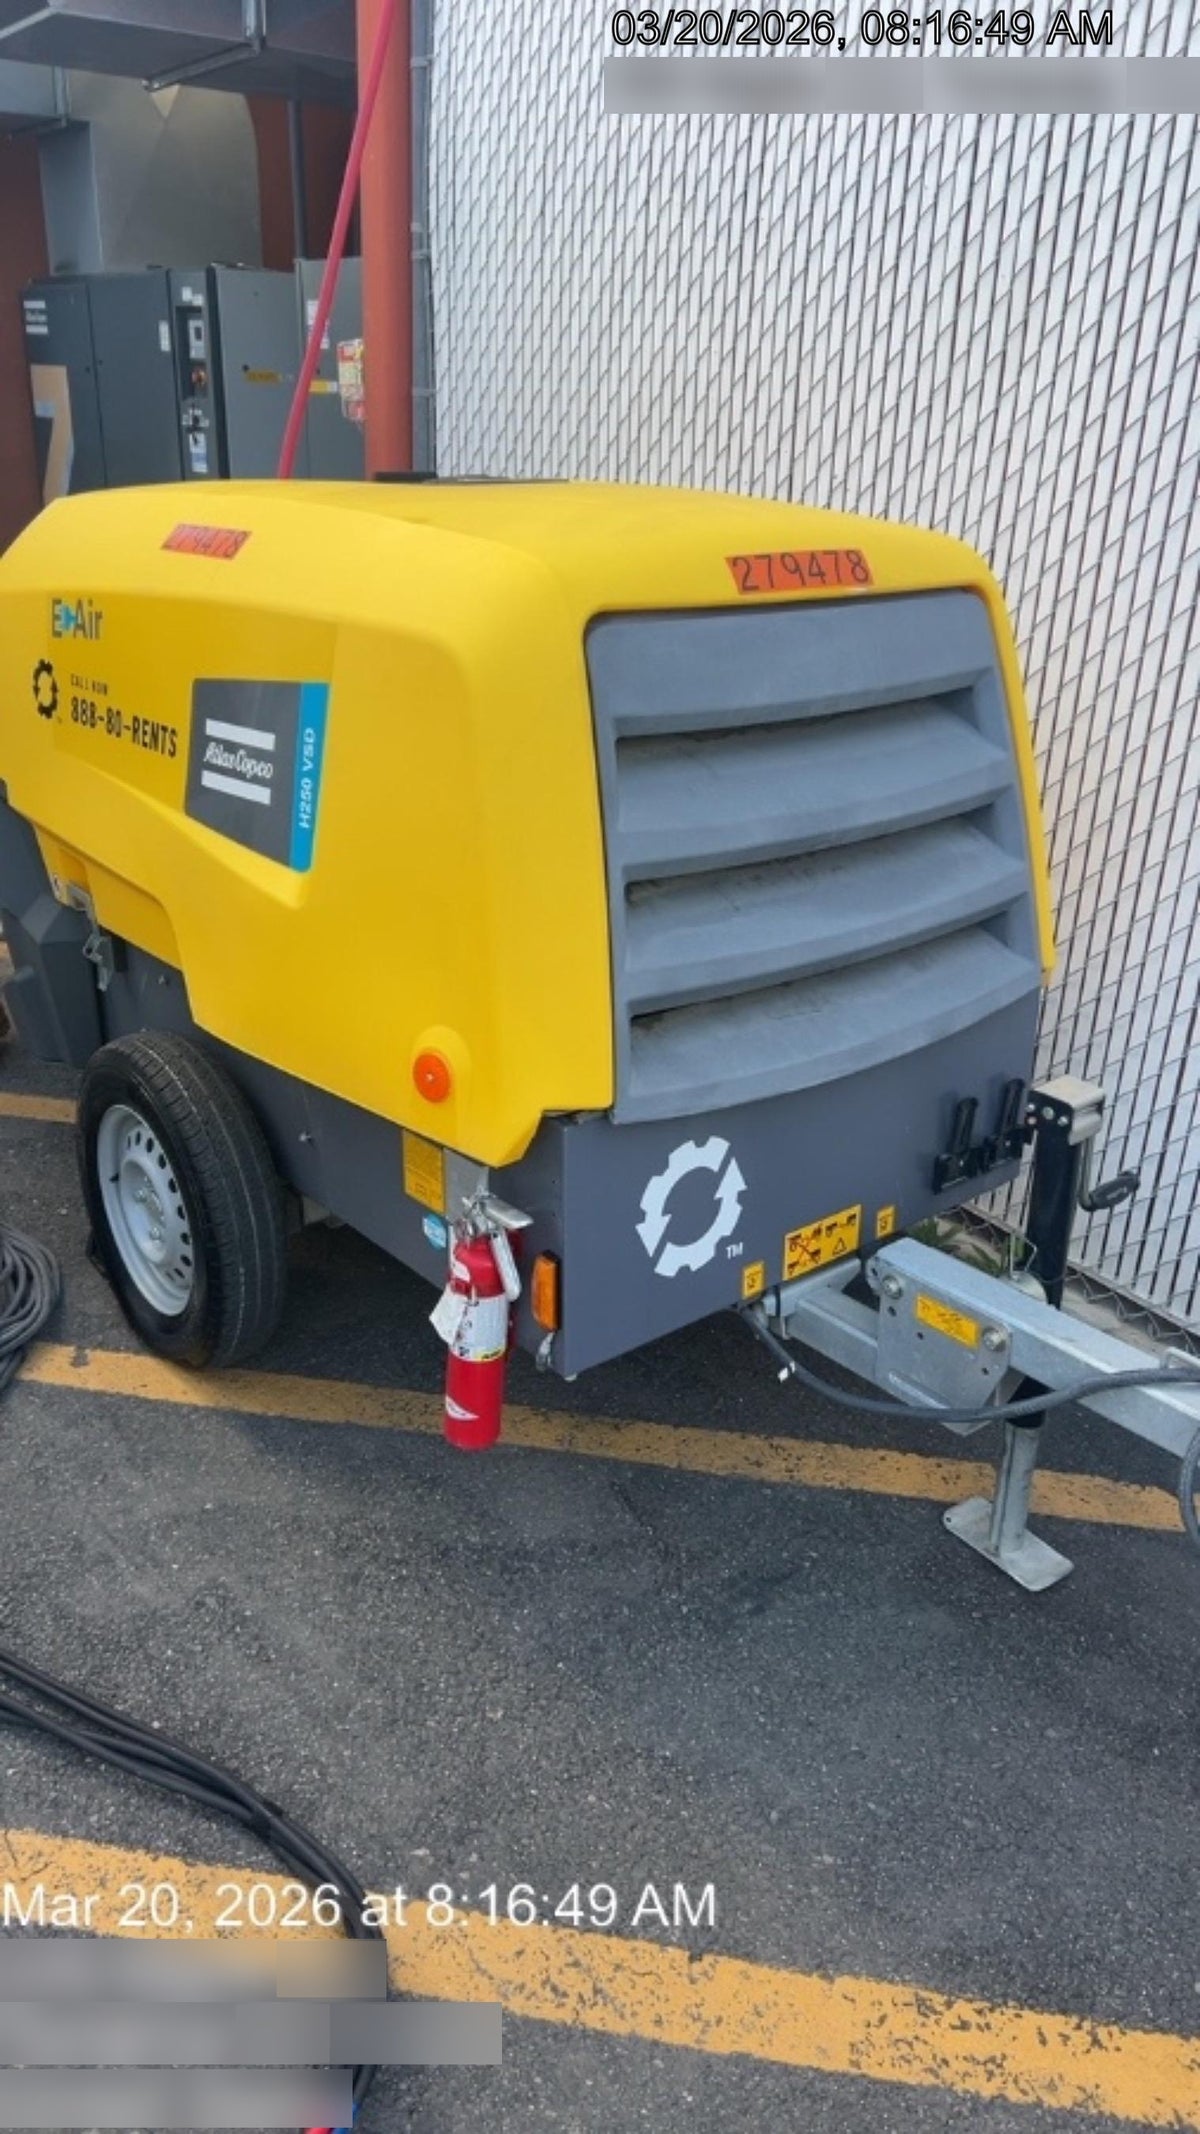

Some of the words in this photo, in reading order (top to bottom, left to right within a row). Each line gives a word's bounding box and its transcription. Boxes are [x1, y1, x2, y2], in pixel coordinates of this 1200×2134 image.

[732, 550, 869, 591] 279478
[71, 696, 178, 759] 888-80-RENTS
[302, 727, 316, 771] VSD
[298, 777, 314, 829] H250
